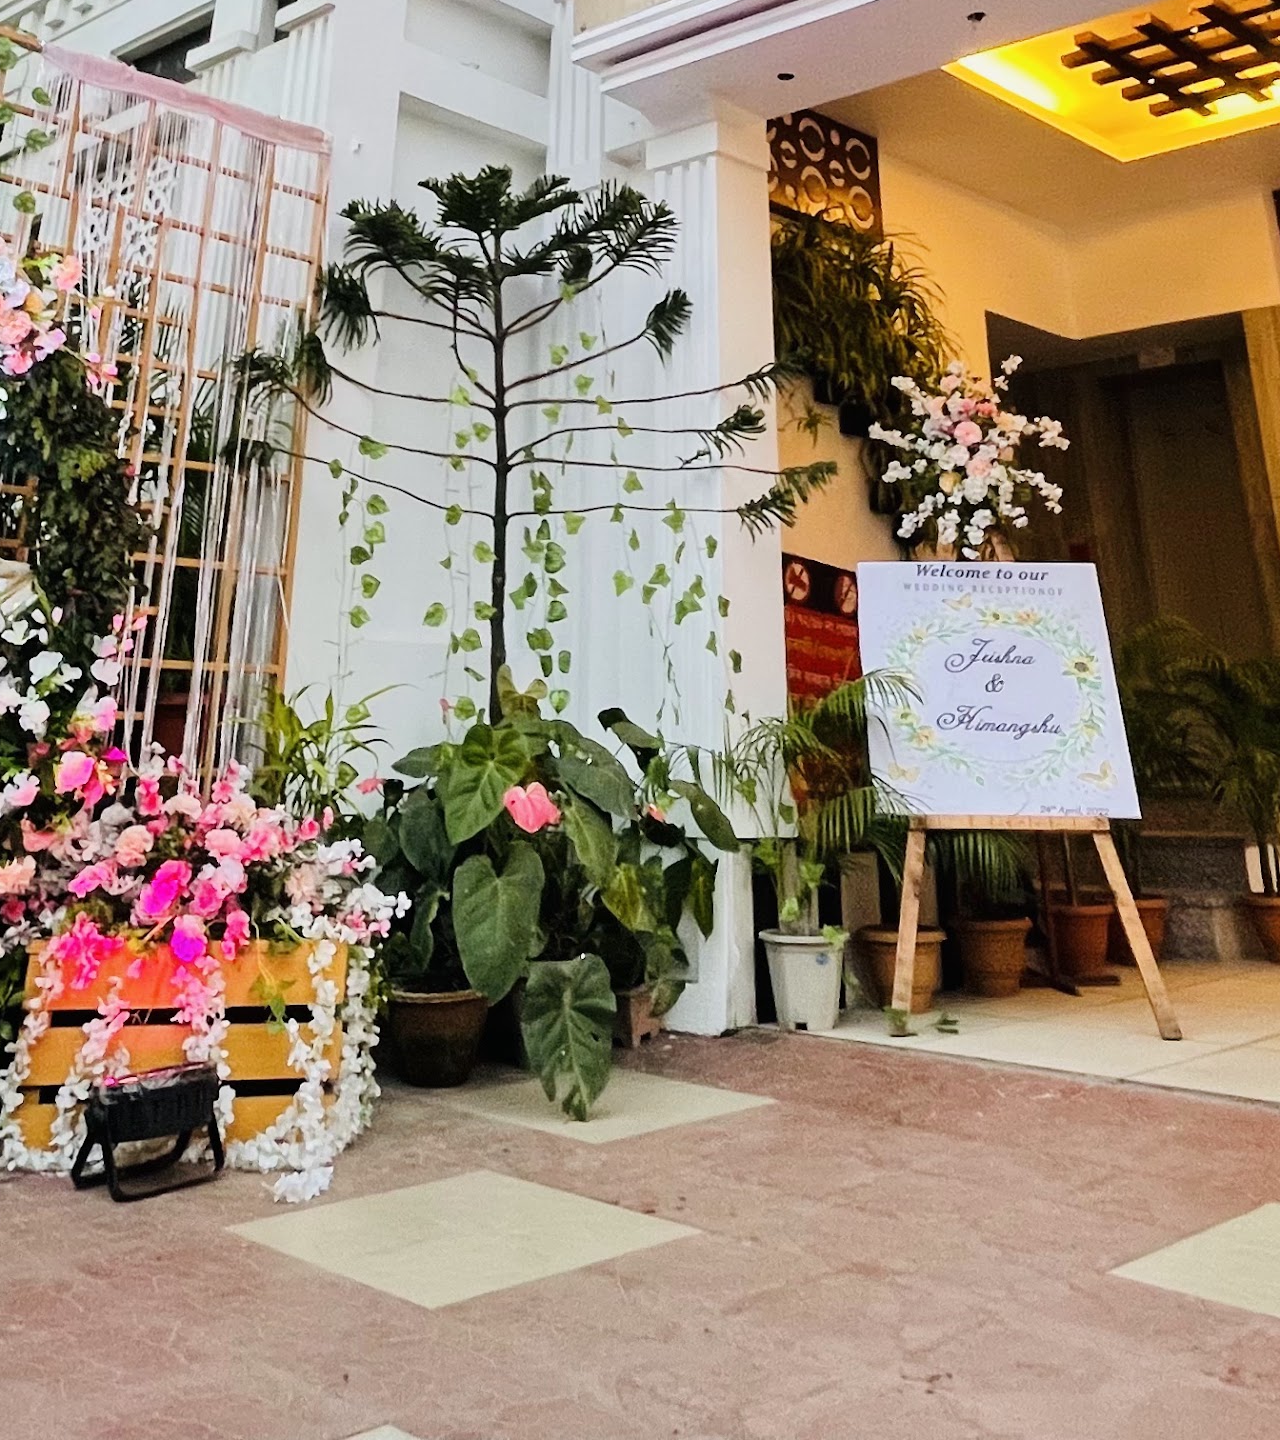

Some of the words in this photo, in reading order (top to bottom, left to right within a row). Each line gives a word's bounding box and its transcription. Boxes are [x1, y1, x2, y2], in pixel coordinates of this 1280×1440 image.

[915, 564, 992, 580] Welcome
[995, 568, 1013, 581] to
[1018, 569, 1050, 582] our
[903, 582, 965, 593] WEDDING
[984, 673, 1005, 693] &
[936, 704, 1061, 740] Himangshu
